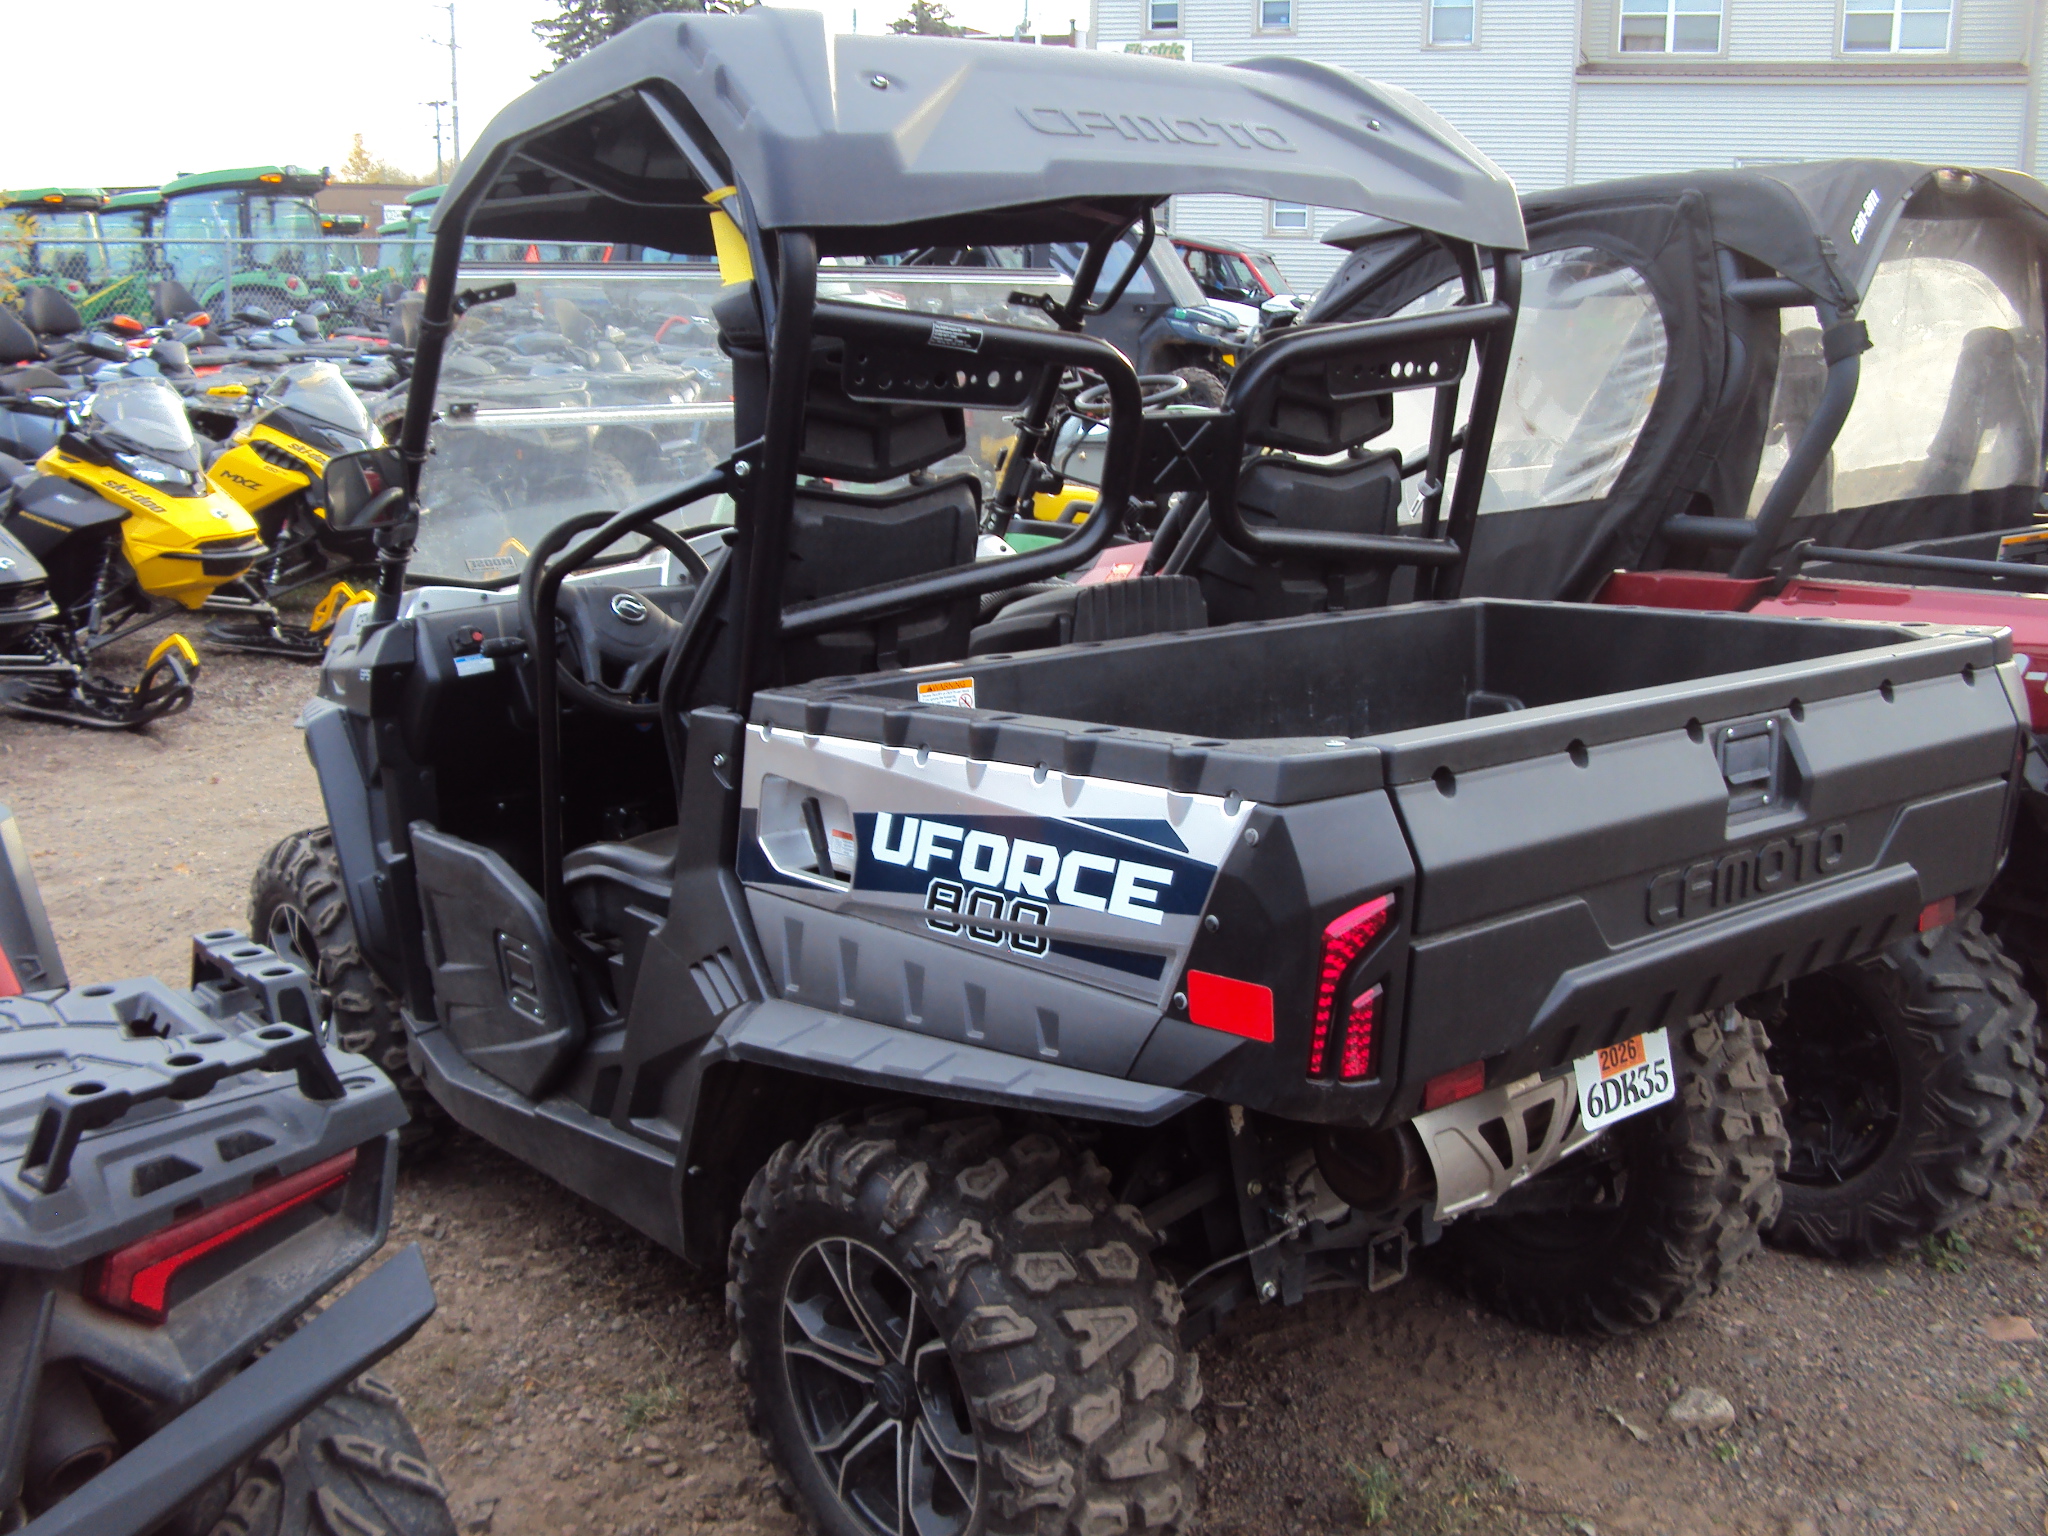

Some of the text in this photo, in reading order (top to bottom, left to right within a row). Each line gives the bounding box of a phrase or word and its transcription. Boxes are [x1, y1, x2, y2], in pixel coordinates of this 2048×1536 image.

[1015, 106, 1298, 152] CFMOTO
[101, 480, 167, 513] ski-doo
[220, 470, 264, 491] MXZ
[871, 811, 1175, 926] UFORCE
[1645, 823, 1848, 925] CFMOTO
[924, 877, 1051, 959] 800
[1600, 1039, 1637, 1072] 2026
[1587, 1058, 1669, 1118] 6DK35
